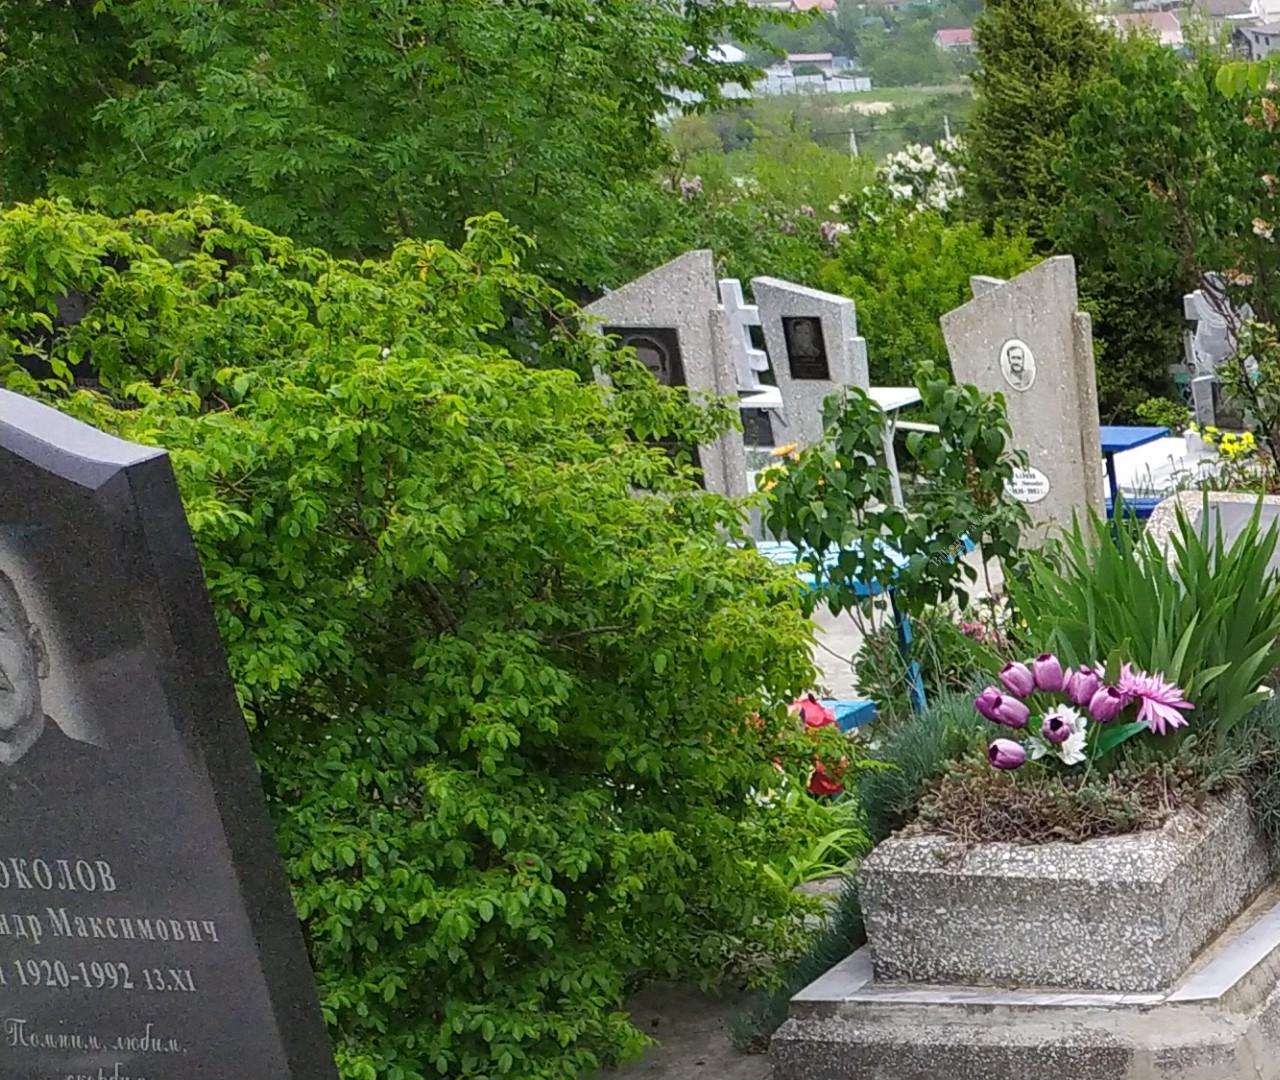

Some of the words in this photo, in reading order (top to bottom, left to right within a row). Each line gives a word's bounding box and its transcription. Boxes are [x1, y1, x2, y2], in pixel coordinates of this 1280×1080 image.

[45, 907, 219, 942] Максимович
[13, 959, 134, 990] 1920-1992
[142, 968, 197, 992] 13.XI
